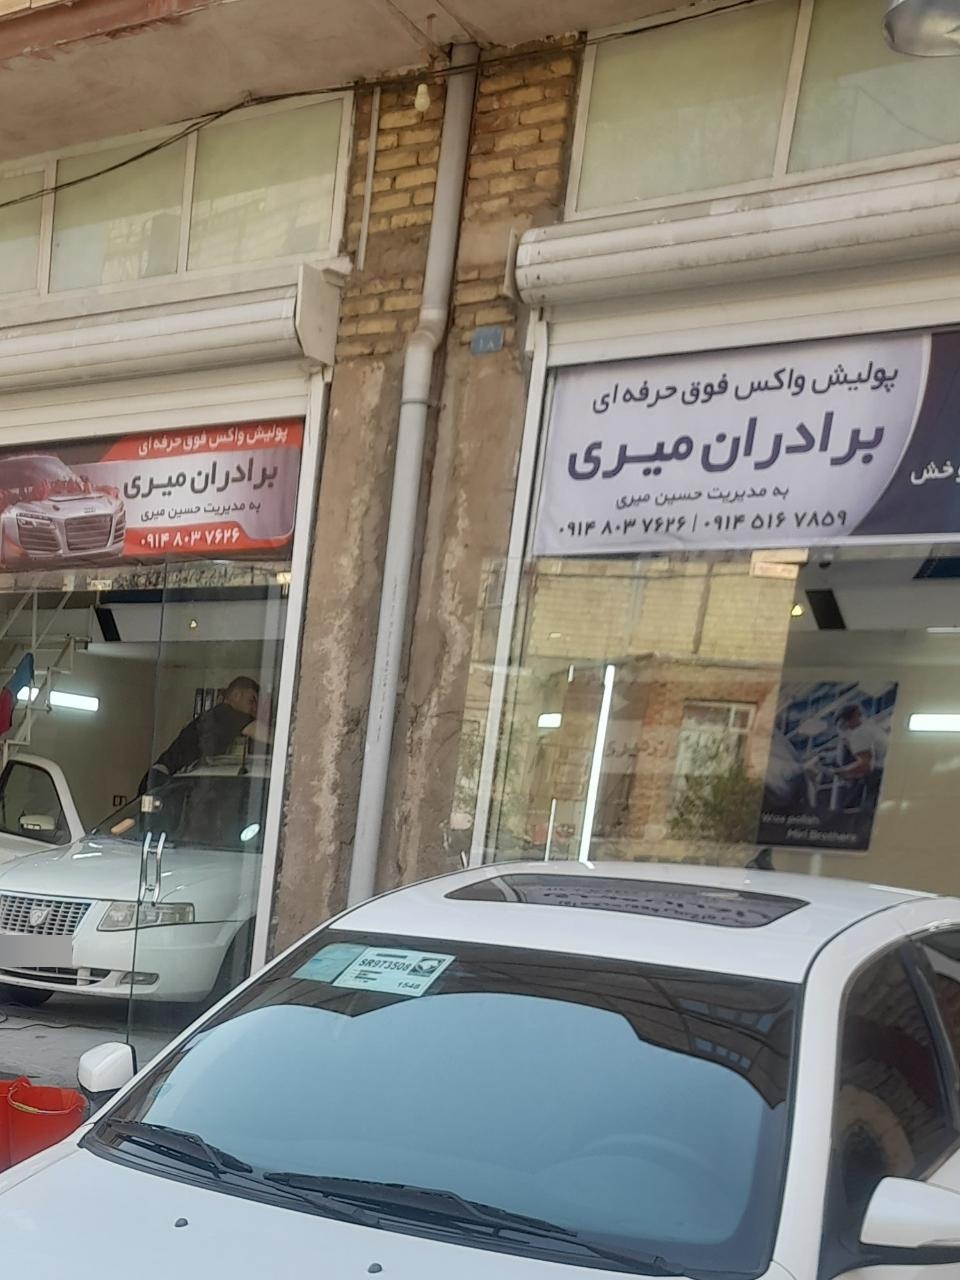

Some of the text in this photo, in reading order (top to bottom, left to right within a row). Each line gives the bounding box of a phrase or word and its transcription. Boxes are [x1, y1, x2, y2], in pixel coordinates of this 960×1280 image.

[681, 373, 729, 405] فوق
[734, 367, 806, 400] واکس
[810, 360, 899, 393] پولیش
[183, 431, 207, 449] فوق
[208, 427, 245, 448] واکس
[246, 424, 288, 443] پولیش
[568, 410, 885, 481] برادران میری
[123, 457, 278, 499] برادران میری
[615, 485, 789, 510] به مدیریت حسین میری
[140, 500, 261, 522] به مدیریت حسین میری
[559, 519, 596, 536] ۰۹۱۴
[601, 519, 636, 535] ۸۰۳
[642, 516, 687, 535] ۷۶۲۶
[704, 514, 745, 531] ۰۹۱۴
[750, 512, 786, 529] ۵۱۶
[794, 510, 847, 528] ۷۸۵۹
[141, 527, 240, 548] ۰۹۱۴ ۸۰۳ ۷۶۲۶
